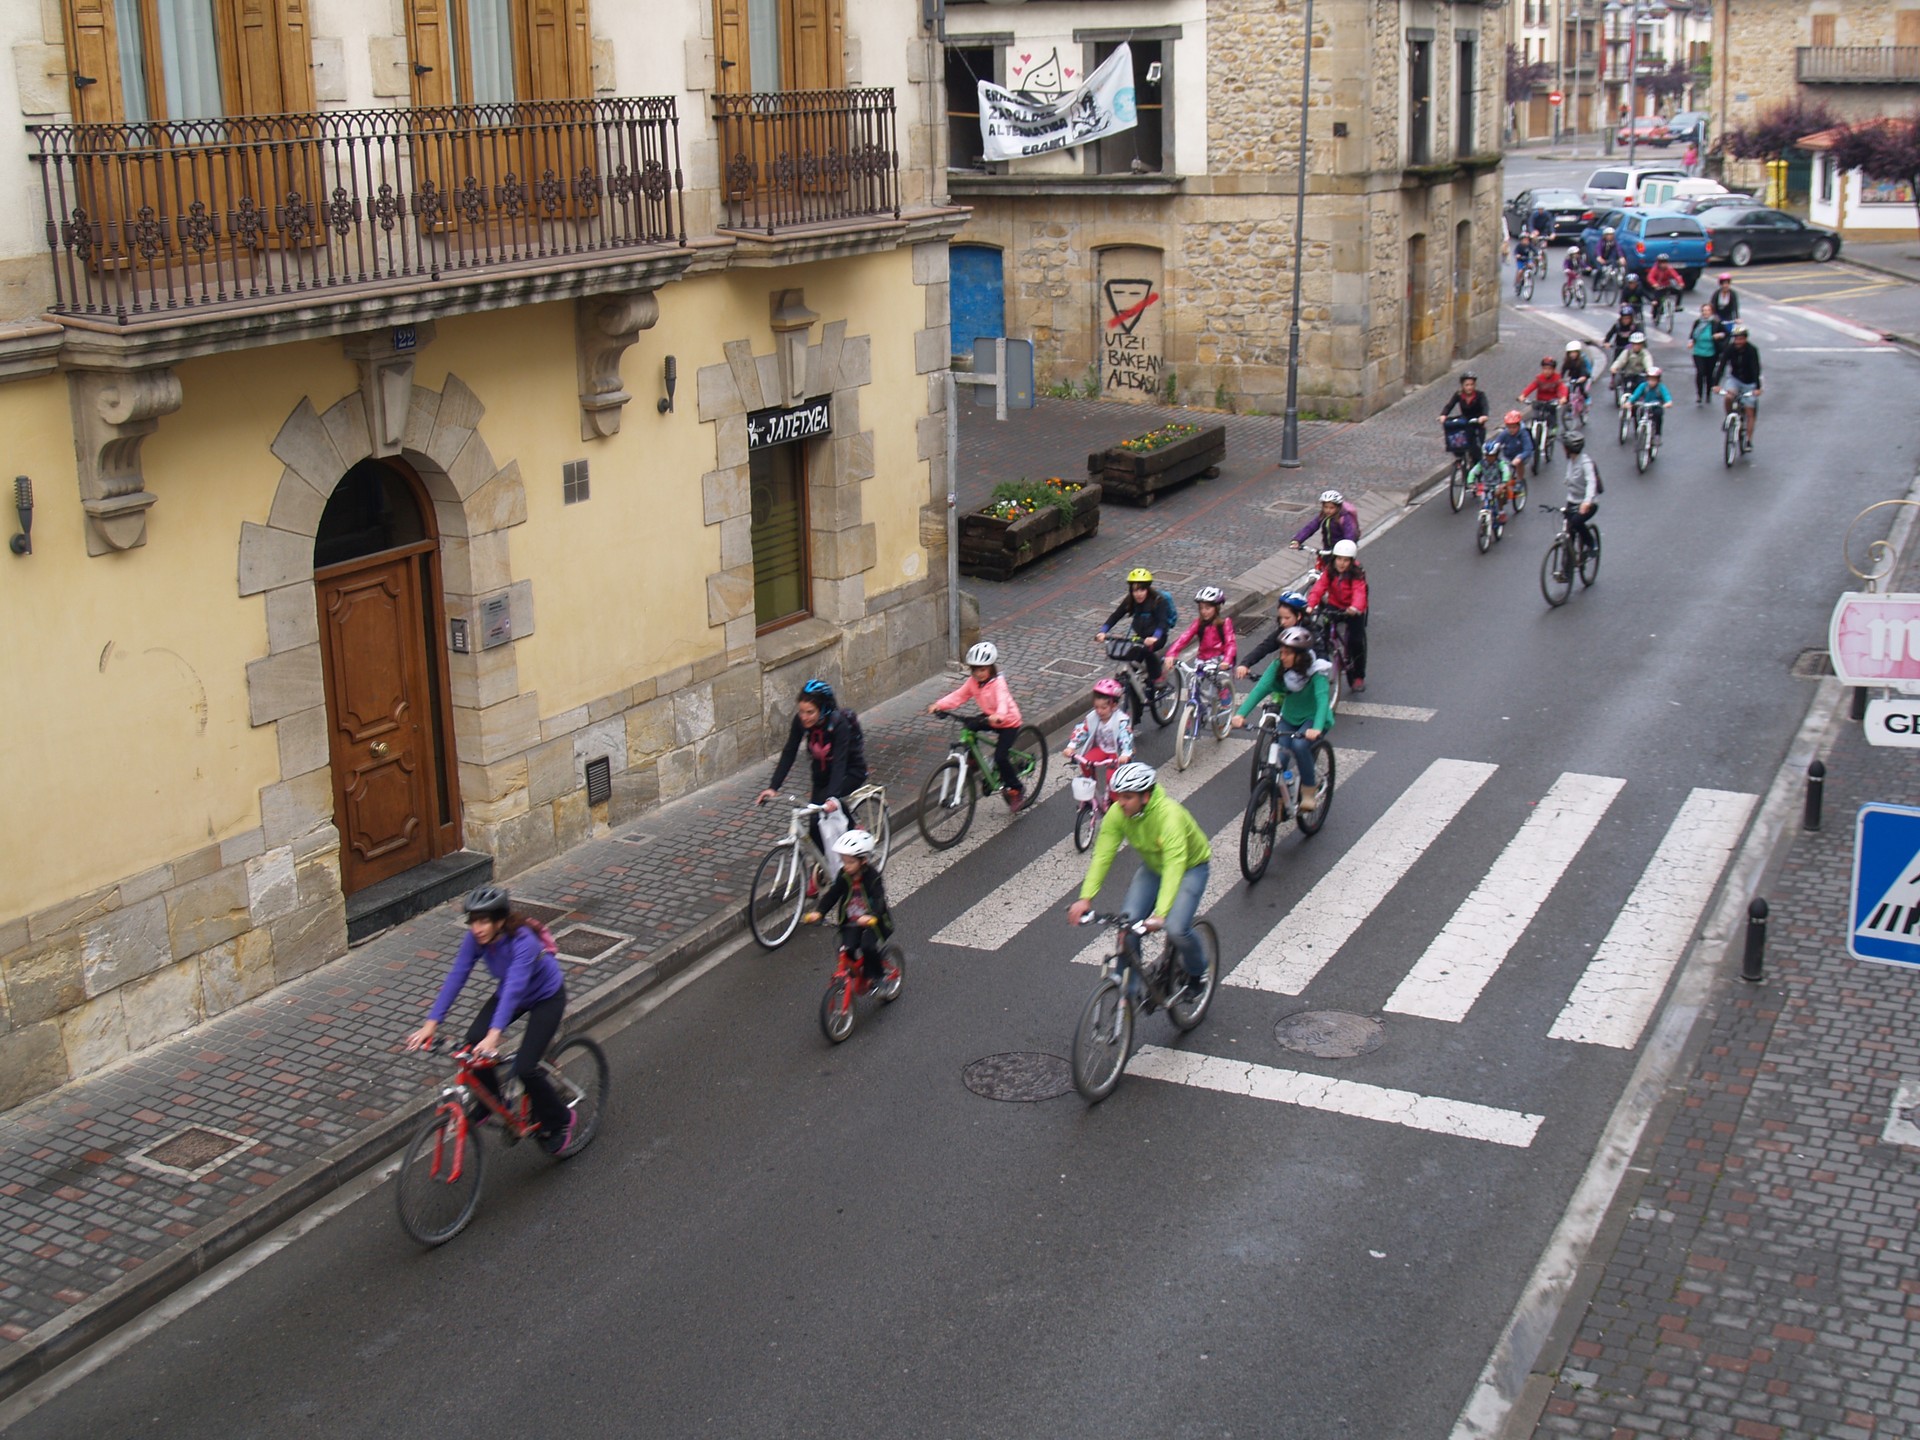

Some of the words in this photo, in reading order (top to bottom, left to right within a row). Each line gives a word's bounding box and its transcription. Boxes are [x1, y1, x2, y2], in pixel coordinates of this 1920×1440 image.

[398, 329, 415, 348] 22
[1105, 332, 1146, 350] UTZI
[1108, 350, 1163, 374] BAKEAN
[766, 405, 828, 443] JATETXEA
